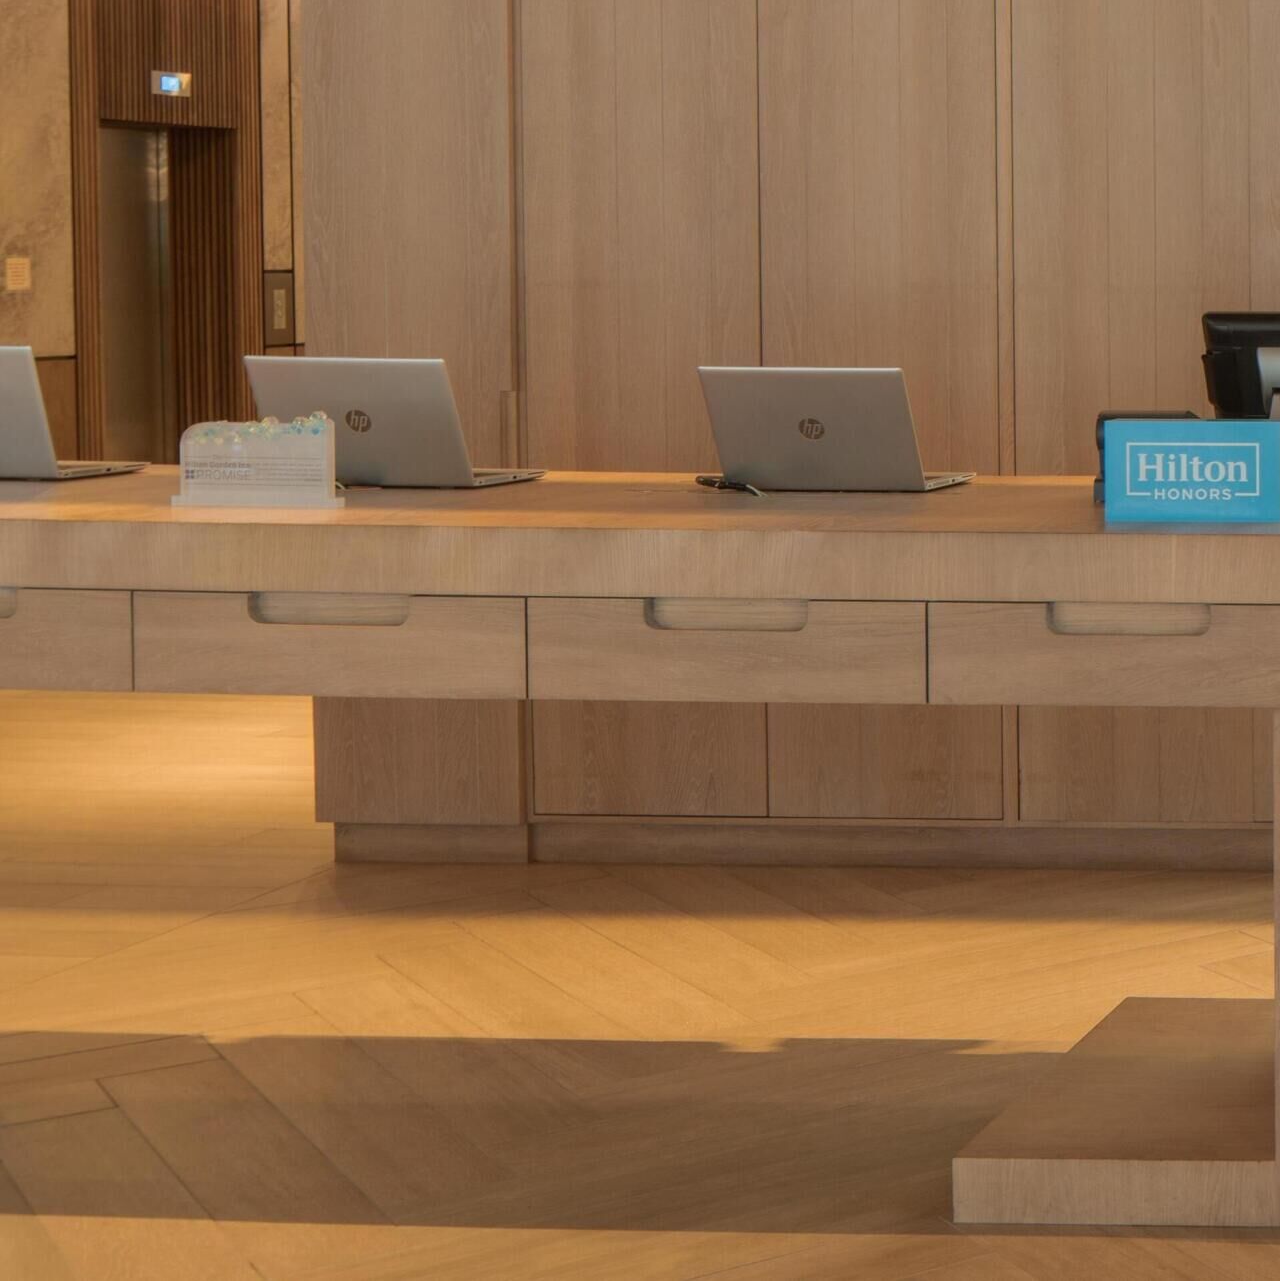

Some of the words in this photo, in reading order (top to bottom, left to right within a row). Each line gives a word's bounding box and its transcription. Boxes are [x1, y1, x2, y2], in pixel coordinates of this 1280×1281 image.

[349, 409, 370, 433] hp
[802, 418, 823, 439] hp
[1136, 452, 1249, 483] Hilton
[1153, 487, 1233, 501] HONORS
